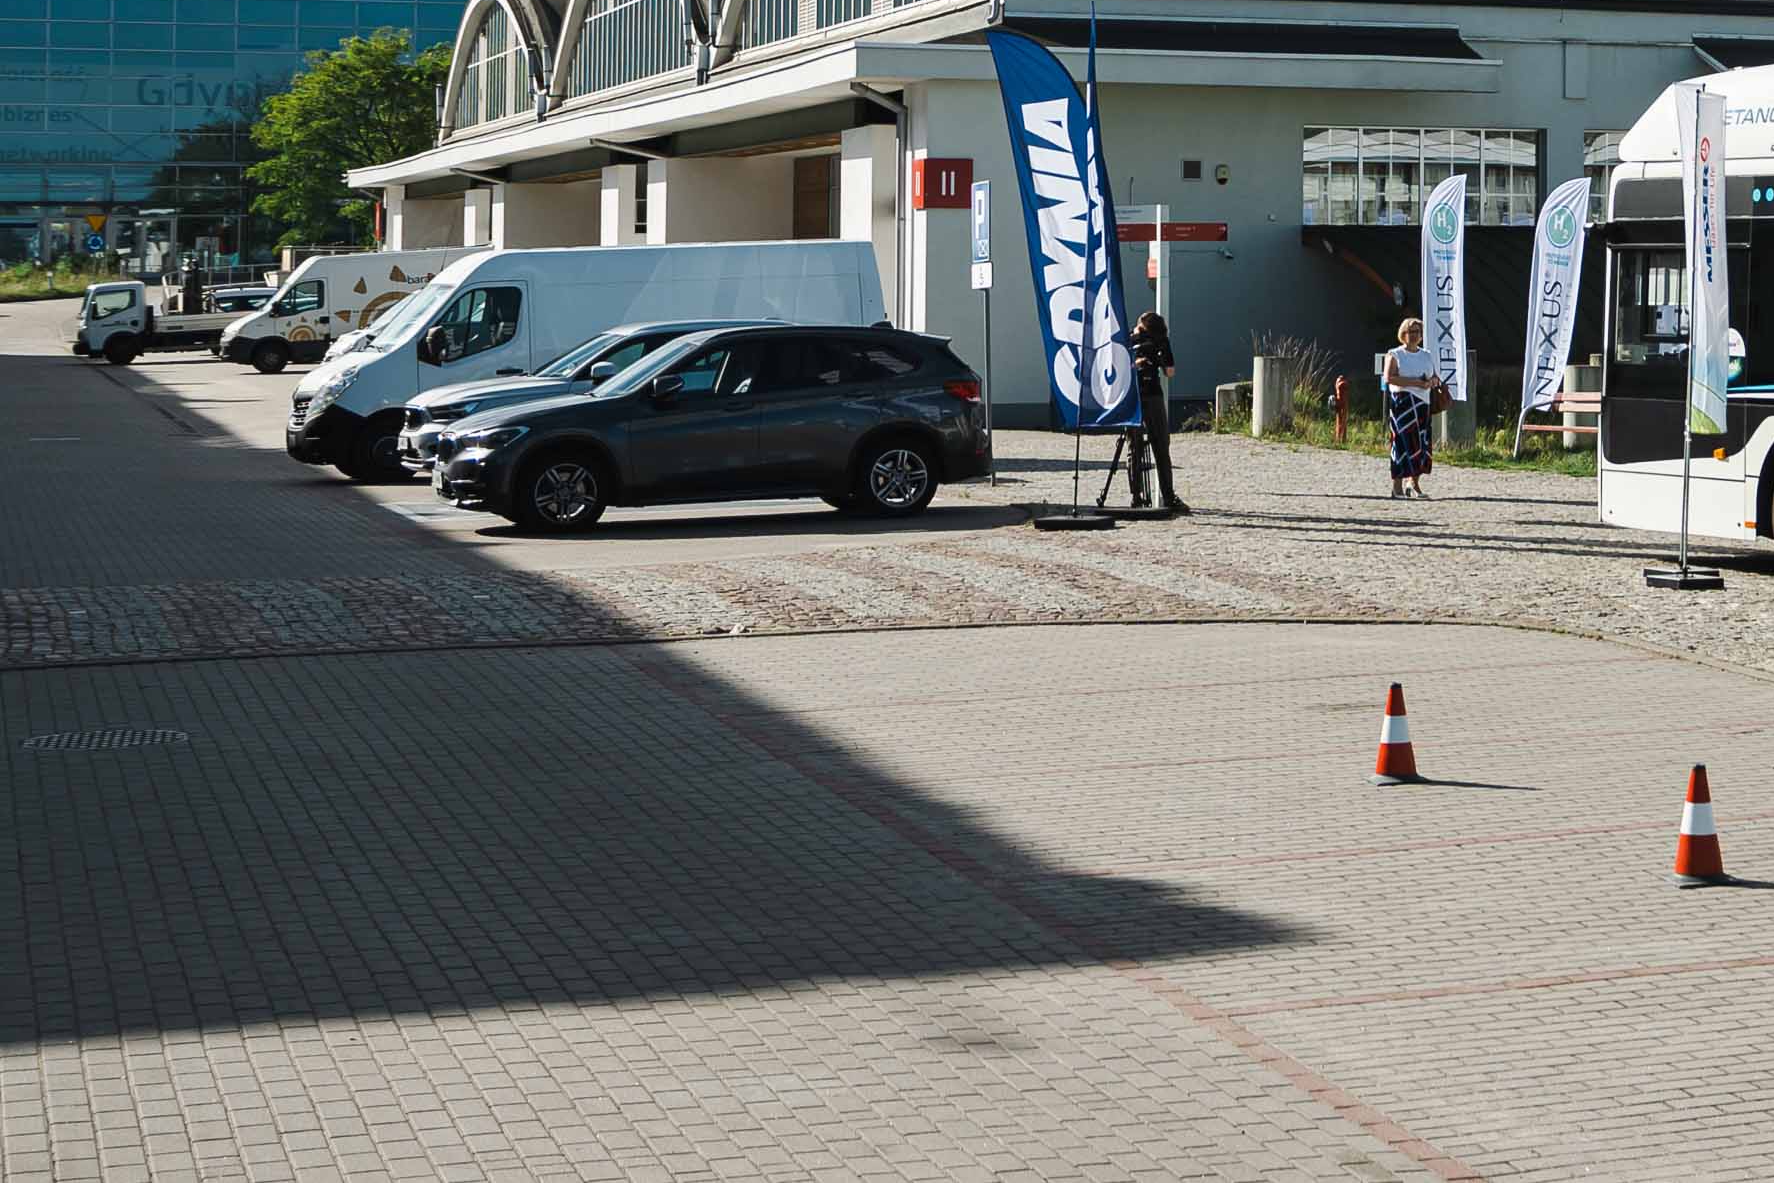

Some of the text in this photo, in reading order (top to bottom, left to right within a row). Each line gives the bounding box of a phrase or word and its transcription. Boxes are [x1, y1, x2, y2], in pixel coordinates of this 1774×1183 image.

[975, 189, 985, 239] P
[1436, 274, 1458, 387] NEXUS
[1536, 280, 1563, 397] NEXUS
